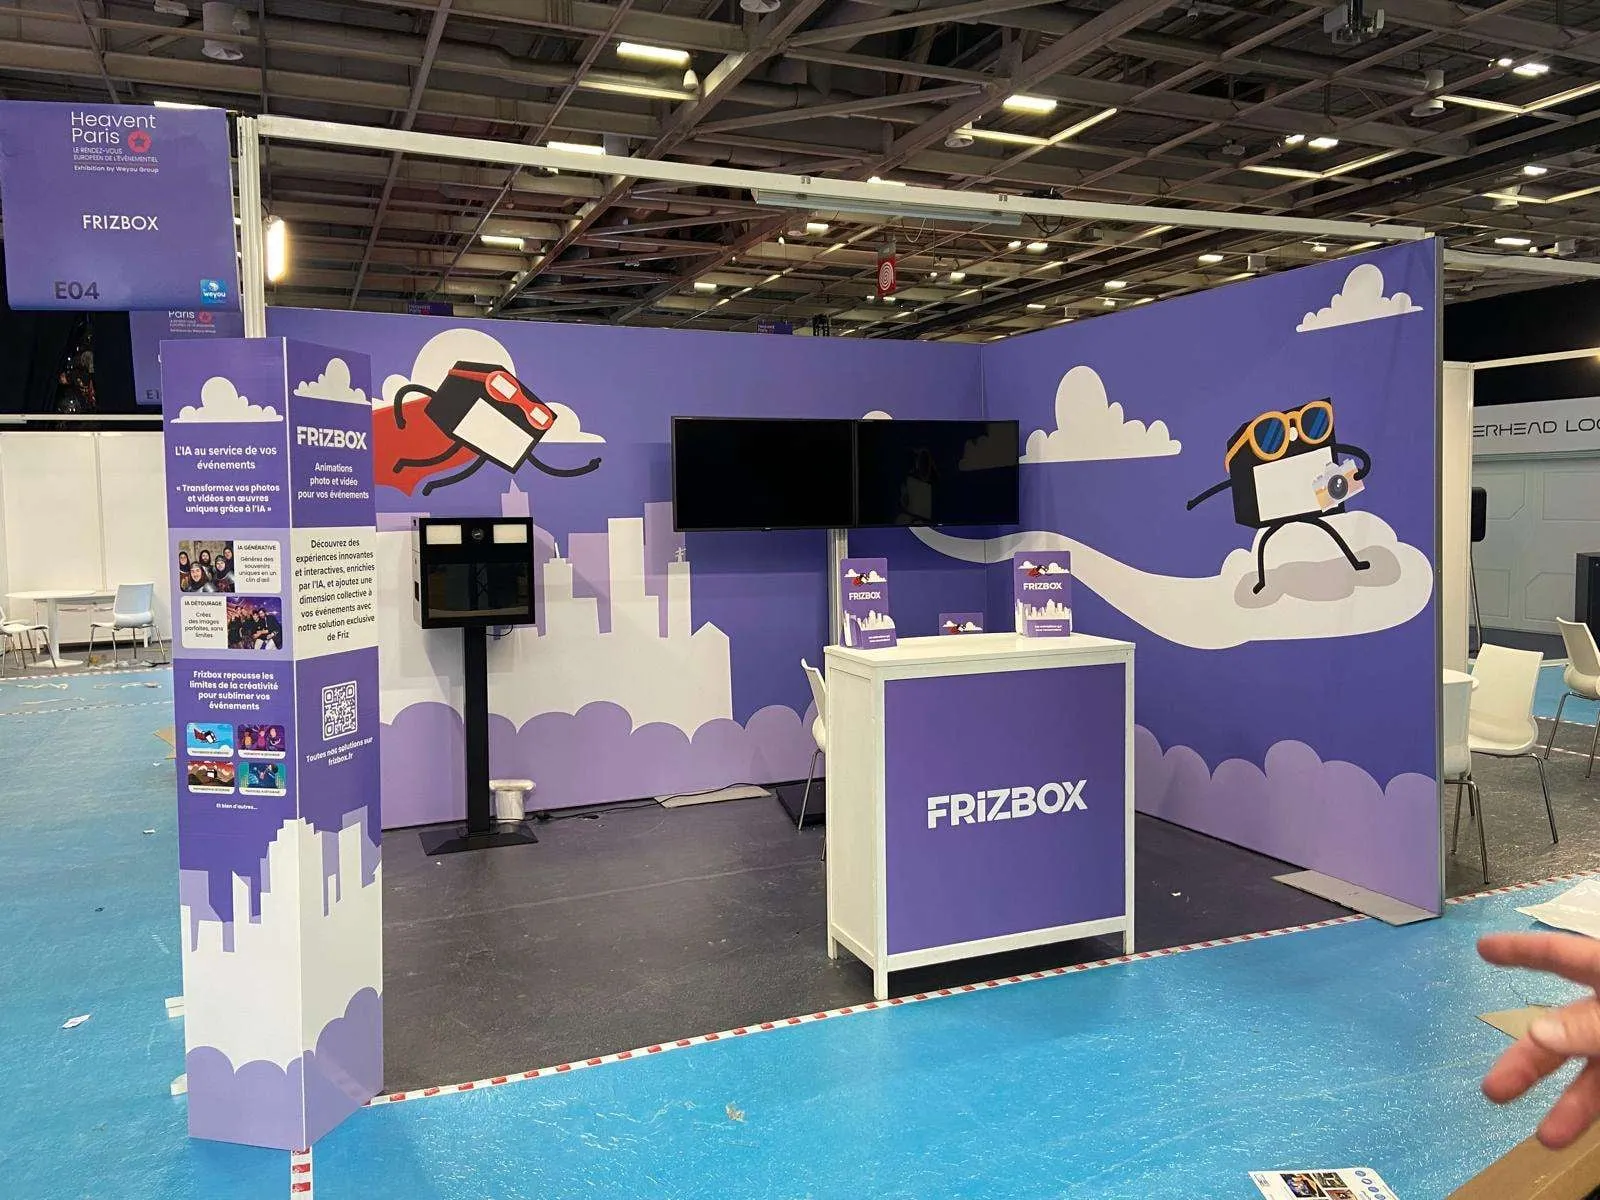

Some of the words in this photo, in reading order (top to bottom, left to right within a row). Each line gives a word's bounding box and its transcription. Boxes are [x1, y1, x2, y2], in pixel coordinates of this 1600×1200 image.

[71, 111, 156, 128] Heavent
[72, 127, 120, 144] Paris
[80, 147, 123, 155] RENDEZ-VOUS
[74, 164, 105, 172] Exhibition
[82, 214, 159, 231] FRIZBOX
[54, 281, 100, 300] E04
[1565, 418, 1600, 433] LO
[175, 446, 192, 456] L'IA
[194, 447, 206, 456] au
[208, 446, 243, 456] service
[244, 446, 258, 455] de
[258, 447, 277, 455] vos
[314, 462, 353, 473] Animations
[309, 476, 331, 486] photo
[331, 477, 340, 485] et
[340, 476, 358, 486] vidéo
[182, 484, 233, 492] Transformez
[250, 484, 280, 493] photos
[196, 494, 224, 502] vidéos
[297, 491, 315, 500] pour
[315, 491, 329, 499] vos
[185, 505, 219, 514] uniques
[219, 505, 244, 515] grâce
[245, 504, 251, 512] à
[311, 539, 348, 549] Découvrez
[348, 538, 360, 547] des
[295, 552, 338, 564] expériences
[338, 551, 374, 561] innovantes
[294, 568, 303, 577] et
[303, 565, 346, 576] interactives,
[346, 562, 375, 572] enrichies
[298, 581, 312, 592] par
[326, 579, 335, 588] et
[335, 577, 359, 588] ajoutez
[360, 576, 373, 584] une
[299, 592, 336, 605] dimension
[336, 588, 367, 600] collective
[301, 609, 314, 618] vos
[356, 602, 372, 610] avec
[297, 622, 318, 632] notre
[318, 618, 346, 630] solution
[346, 614, 375, 625] exclusive
[326, 632, 336, 641] de
[337, 630, 350, 640] Friz
[193, 670, 222, 679] Frizbox
[223, 672, 261, 681] repousse
[262, 672, 275, 680] les
[189, 680, 217, 689] limites
[218, 681, 229, 689] de
[239, 682, 279, 690] créativité
[198, 692, 217, 700] pour
[218, 692, 255, 700] sublimer
[306, 752, 327, 763] Toutes
[326, 747, 338, 757] nos
[337, 739, 364, 753] solutions
[363, 736, 373, 745] sur
